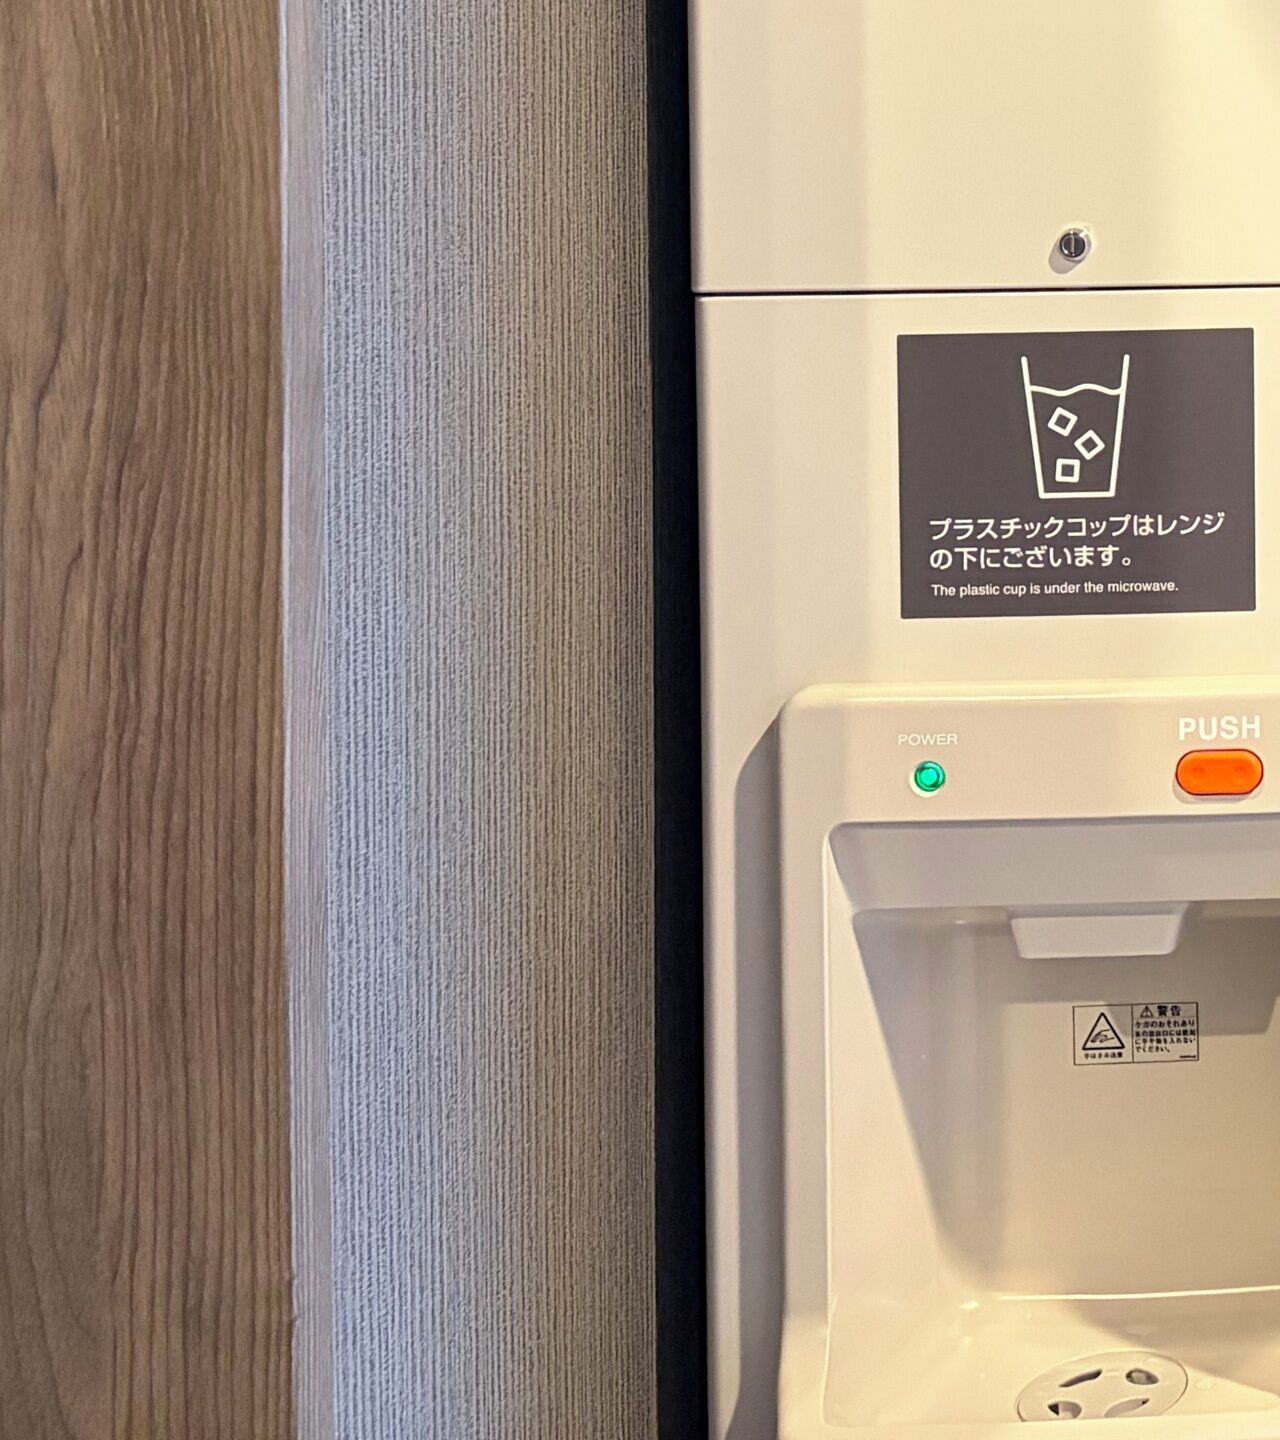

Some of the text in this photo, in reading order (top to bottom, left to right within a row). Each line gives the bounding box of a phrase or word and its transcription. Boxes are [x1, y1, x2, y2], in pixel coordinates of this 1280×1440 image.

[930, 512, 1226, 540] プラスチックコップはレンジ
[930, 544, 1134, 570] の下にございます。
[932, 580, 1179, 598] The plastic cup is under the microwave.
[1178, 715, 1261, 740] PUSH
[898, 733, 958, 746] POWER
[1157, 1006, 1180, 1016] 警告
